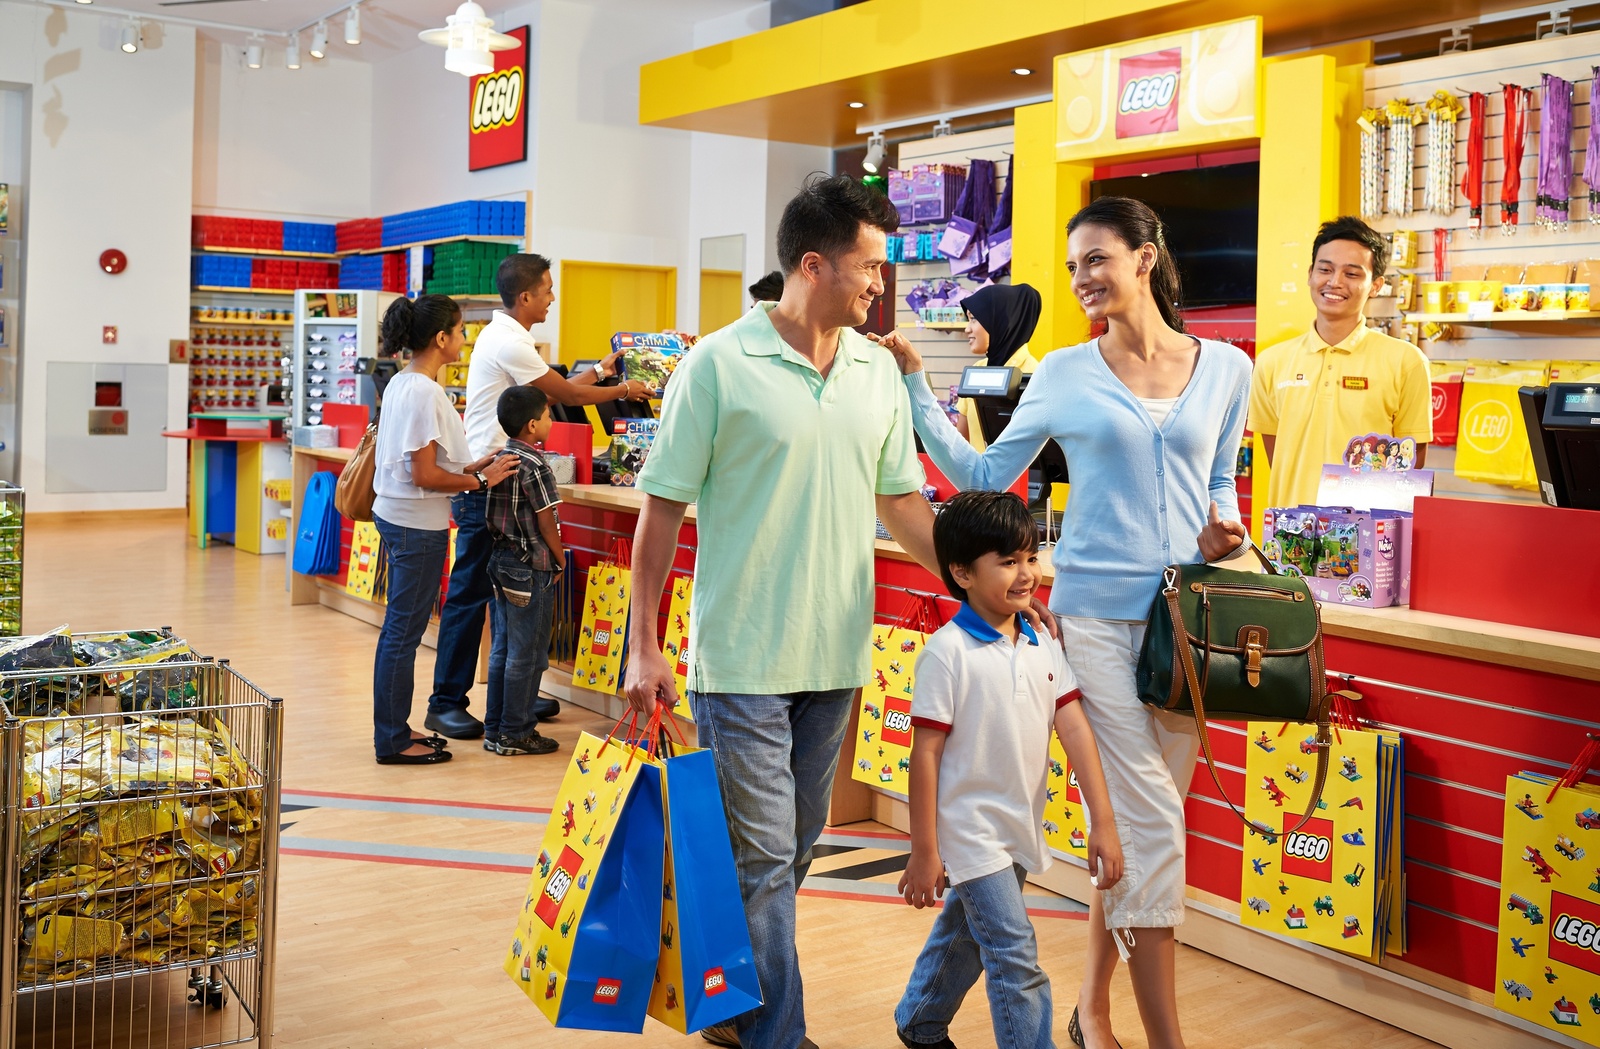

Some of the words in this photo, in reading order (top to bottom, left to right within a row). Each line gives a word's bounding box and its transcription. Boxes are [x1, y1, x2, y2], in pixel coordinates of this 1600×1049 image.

[473, 70, 521, 129] LEGO
[1120, 74, 1176, 112] LEGO
[634, 336, 670, 346] CHIMA
[627, 421, 659, 432] CHIM
[1470, 415, 1508, 438] LEGO
[1378, 540, 1393, 552] New
[594, 630, 610, 645] LEGO
[680, 649, 689, 665] LE
[885, 710, 912, 731] LEGO
[1286, 832, 1330, 861] LEGO
[546, 868, 571, 903] LEGO
[704, 974, 723, 990] LEGO
[596, 985, 619, 996] LEGO
